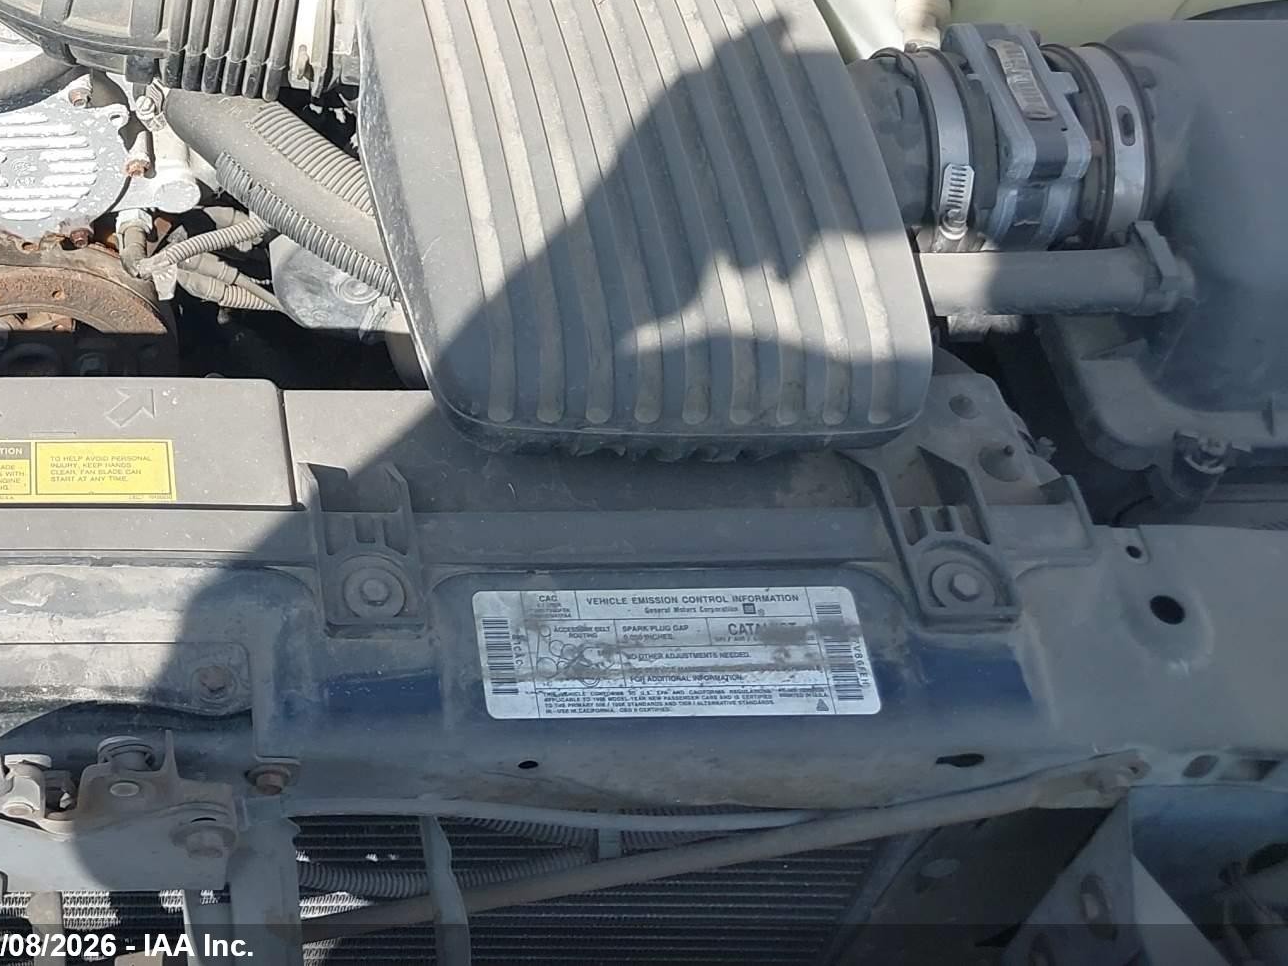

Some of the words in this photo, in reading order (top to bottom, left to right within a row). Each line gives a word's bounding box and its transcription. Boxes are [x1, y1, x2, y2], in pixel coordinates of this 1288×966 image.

[538, 594, 558, 602] CAC
[586, 597, 627, 605] VEHICLE
[631, 596, 678, 605] EMISSION
[682, 595, 729, 604] CONTROL
[732, 594, 800, 603] INFORMATION
[644, 606, 671, 615] General
[673, 606, 697, 614] Motors
[699, 605, 739, 614] Corporation
[622, 625, 649, 633] SPARK
[650, 624, 671, 632] PLUG
[673, 624, 689, 632] GAP
[638, 652, 663, 660] OTHER
[630, 675, 645, 683] FOR
